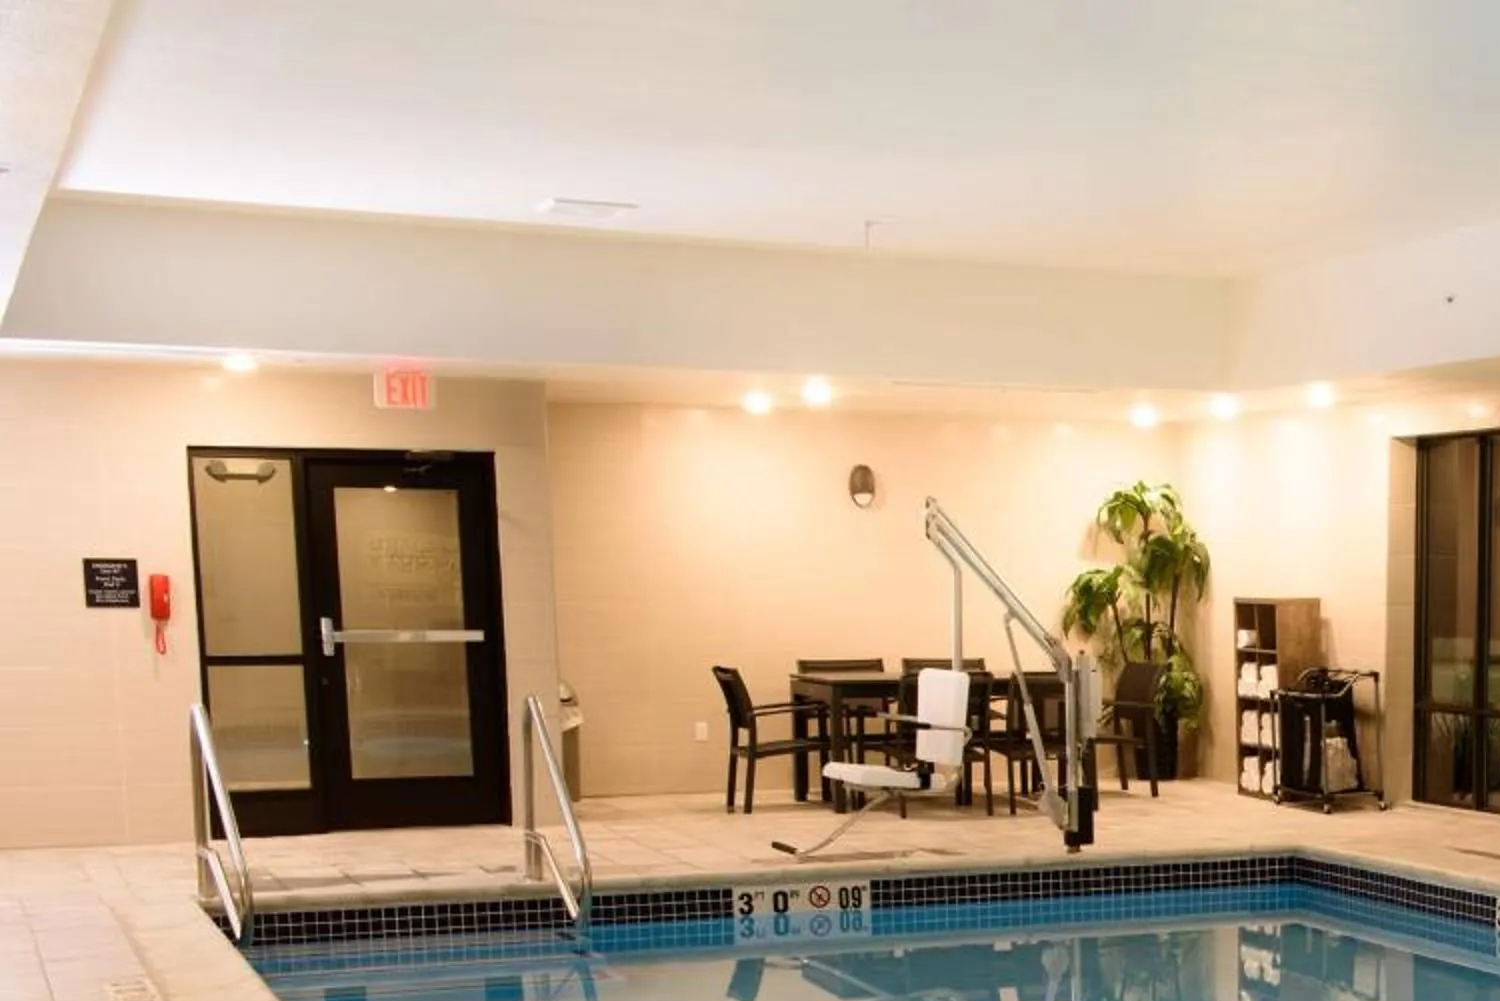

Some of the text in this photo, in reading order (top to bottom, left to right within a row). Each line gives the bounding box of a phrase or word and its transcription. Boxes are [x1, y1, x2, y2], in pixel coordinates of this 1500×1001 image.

[386, 372, 428, 408] EXIT
[738, 892, 754, 915] 3
[773, 890, 789, 914] 0
